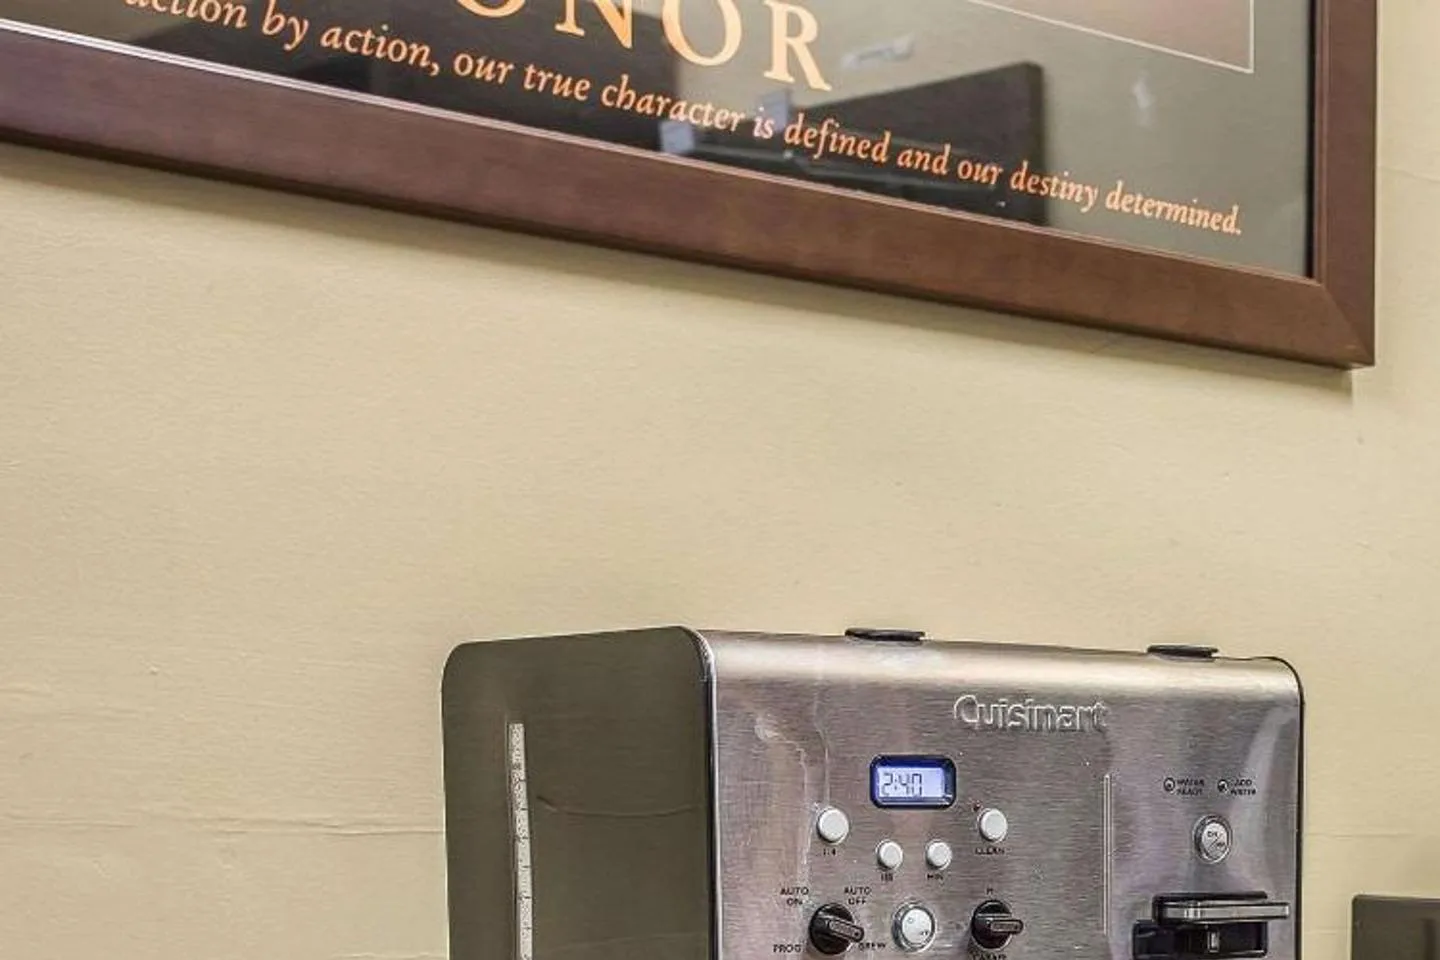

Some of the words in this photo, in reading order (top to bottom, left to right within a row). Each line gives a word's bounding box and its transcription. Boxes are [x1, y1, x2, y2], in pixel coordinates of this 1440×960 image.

[262, 0, 309, 51] by
[320, 24, 440, 77] action,
[453, 53, 515, 84] our
[522, 62, 591, 101] true
[601, 75, 746, 132] character
[753, 106, 774, 139] is
[784, 109, 891, 165] defined
[896, 142, 951, 176] and
[957, 158, 1003, 187] our
[1009, 160, 1099, 214] destiny
[1105, 182, 1243, 236] determined.
[953, 694, 1108, 733] Cuisinart
[780, 887, 809, 895] AUTO
[844, 887, 872, 895] AUTO
[787, 898, 803, 906] ON
[848, 897, 866, 905] OFF
[773, 943, 802, 953] PROG
